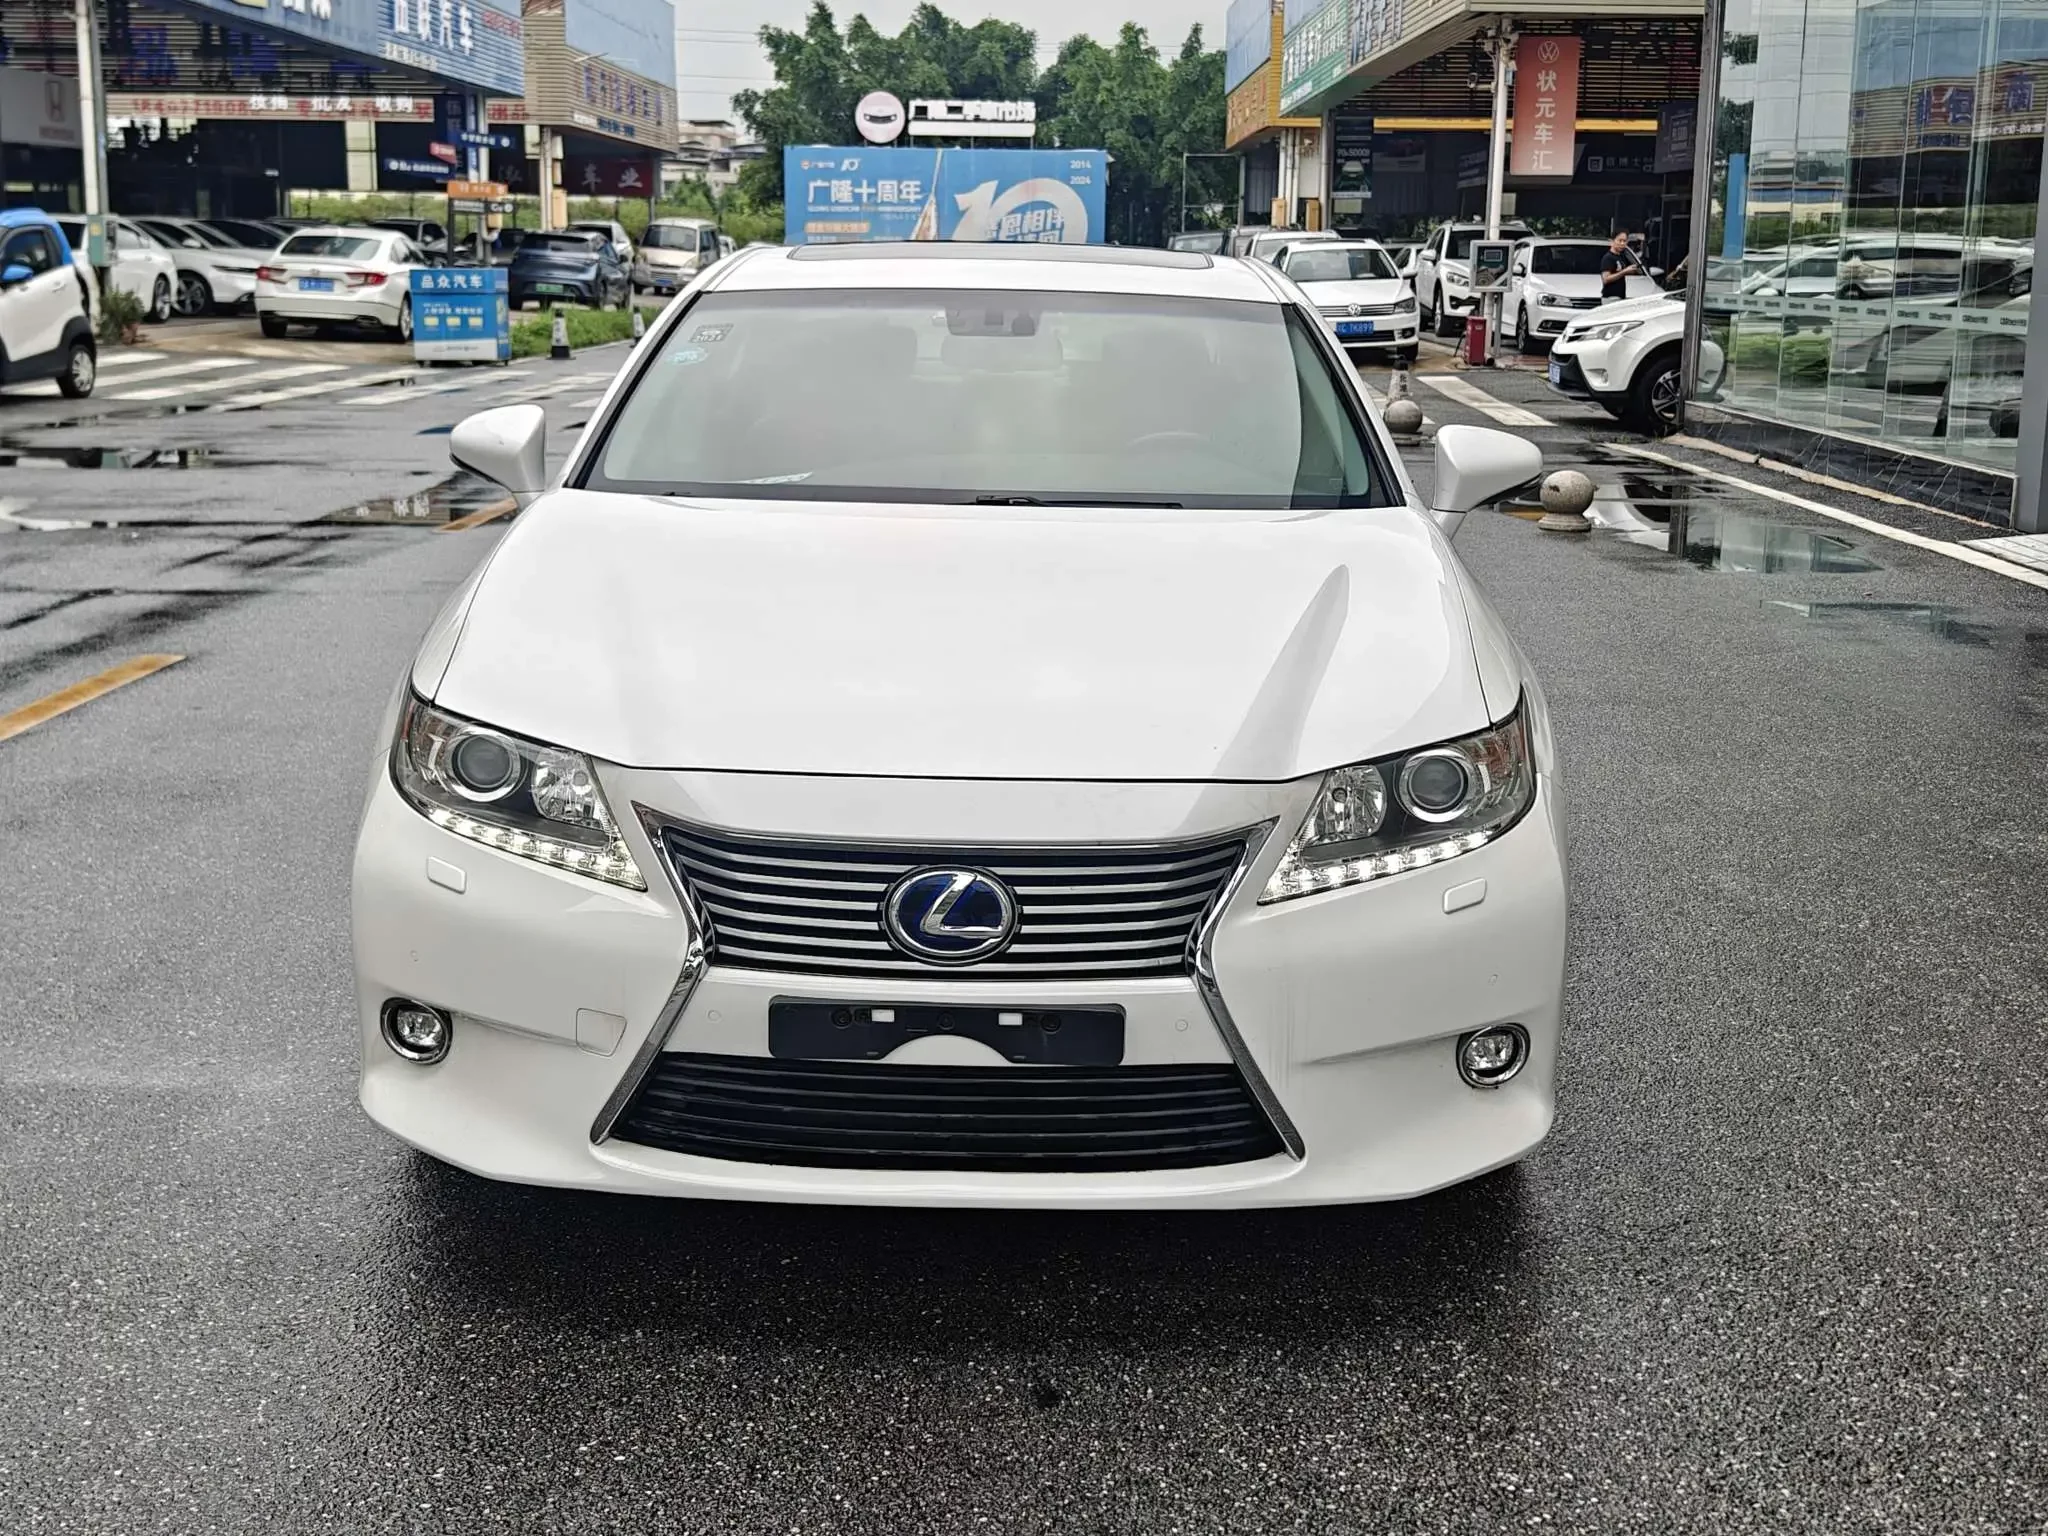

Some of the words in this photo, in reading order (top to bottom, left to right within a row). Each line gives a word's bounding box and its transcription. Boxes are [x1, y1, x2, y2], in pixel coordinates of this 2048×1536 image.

[1532, 69, 1558, 171] 状元车汇
[1070, 159, 1092, 169] 2014
[807, 179, 924, 204] 广隆十周年
[421, 273, 484, 289] 品众汽车
